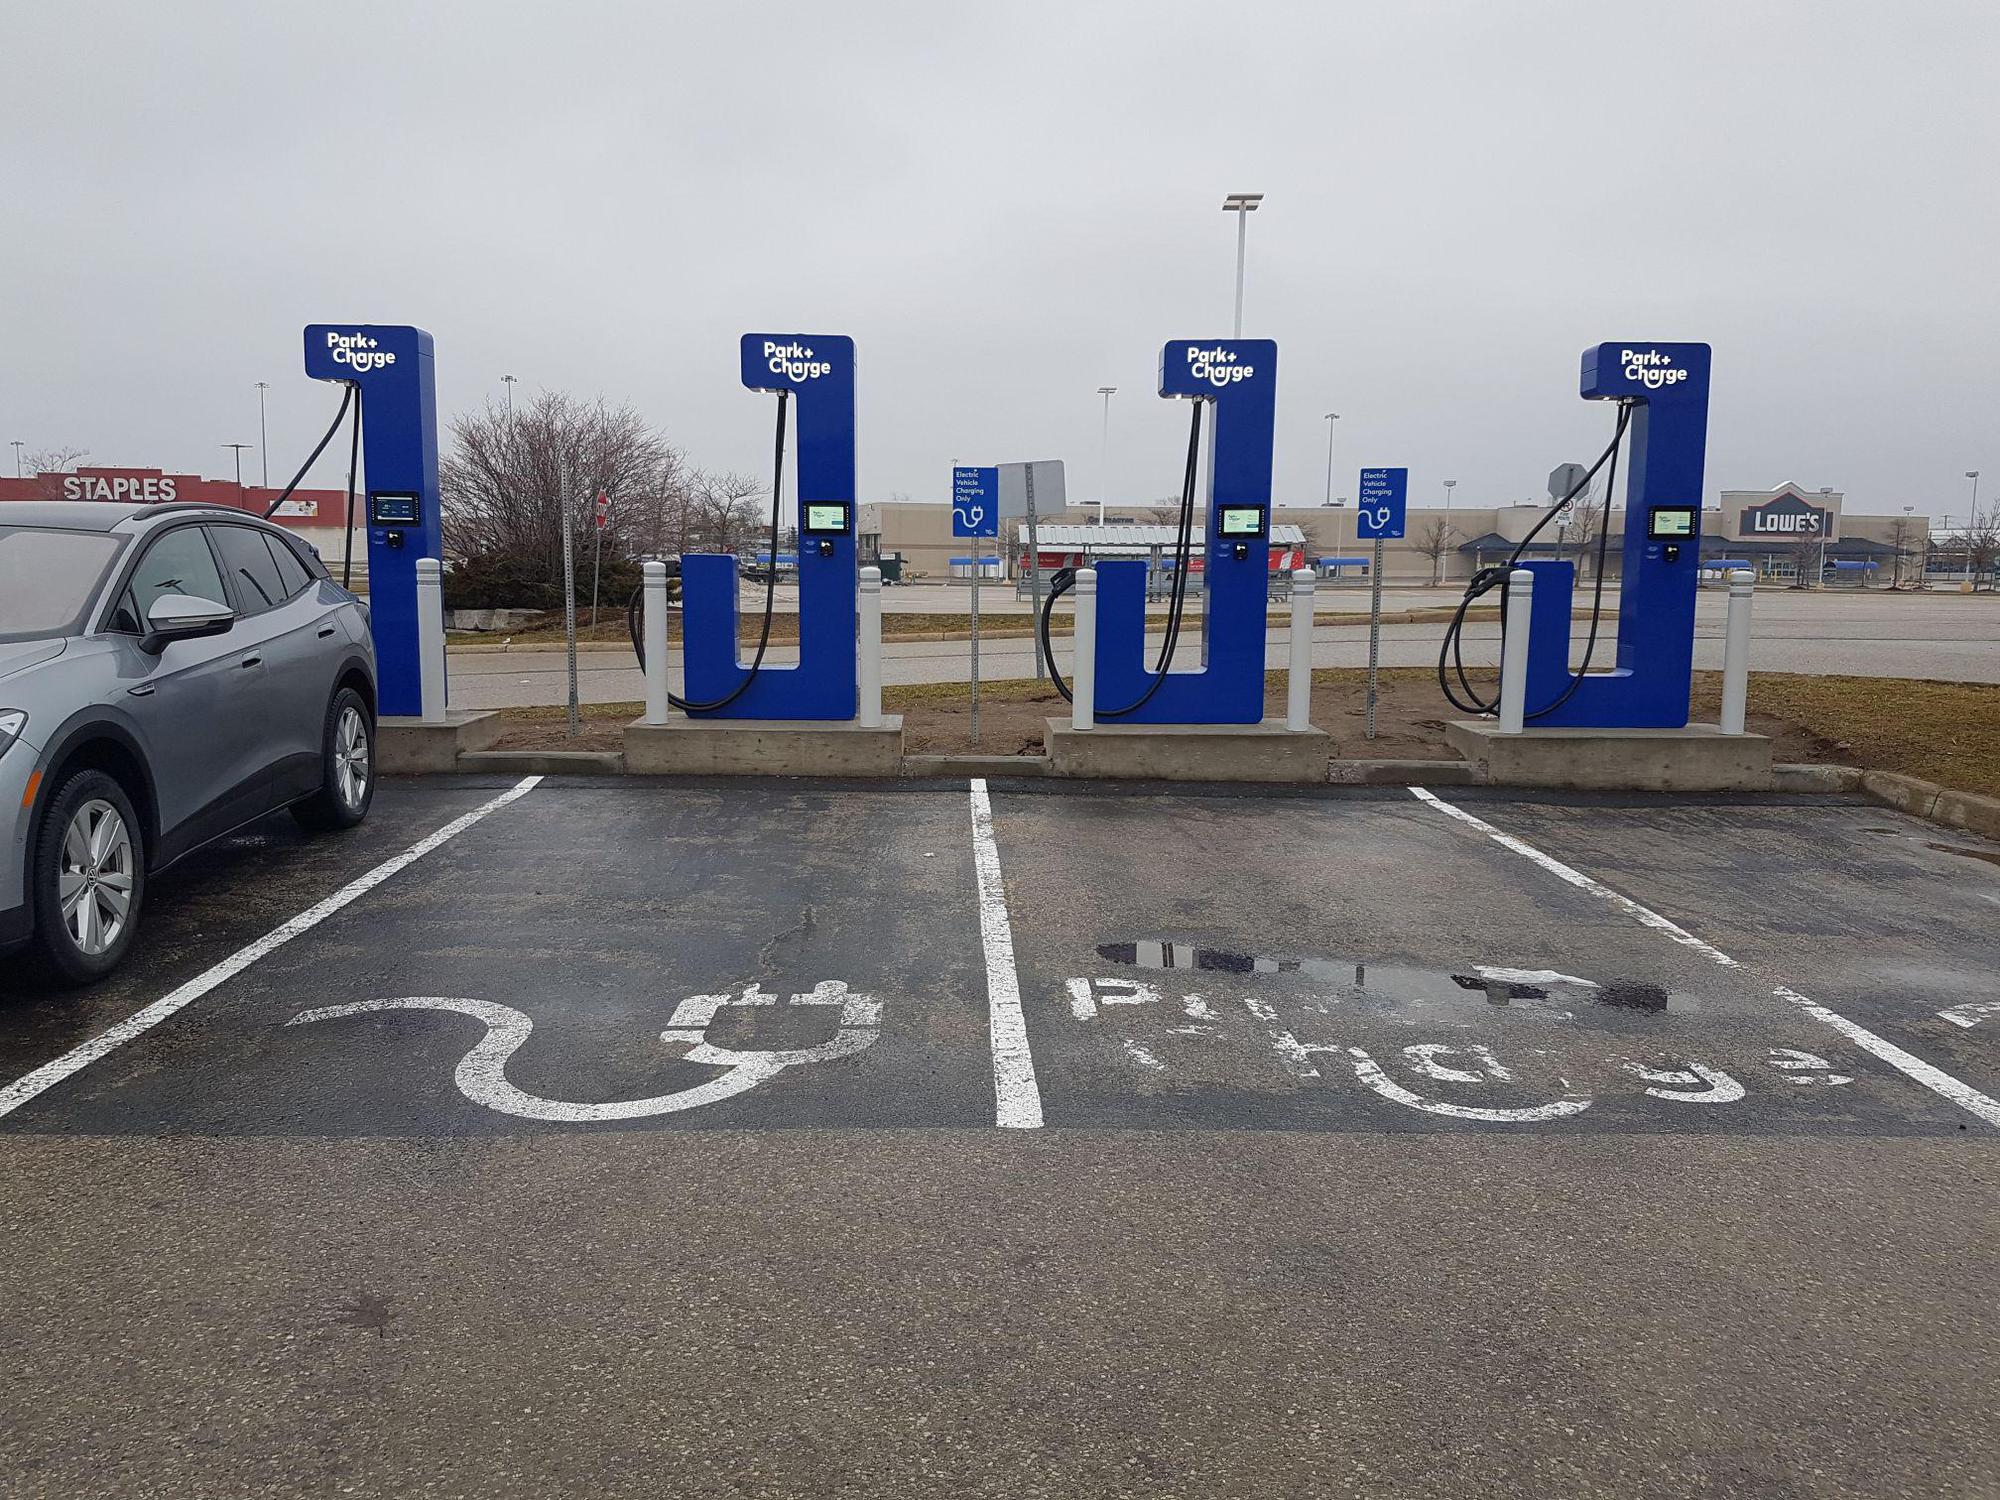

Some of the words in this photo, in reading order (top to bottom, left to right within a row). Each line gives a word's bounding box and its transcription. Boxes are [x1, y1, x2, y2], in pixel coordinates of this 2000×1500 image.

[327, 332, 378, 348] Park+
[763, 341, 814, 358] Park+
[1187, 346, 1237, 363] Park+
[1621, 349, 1671, 365] Park+
[332, 347, 396, 372] Charge
[769, 357, 831, 382] Charge
[1191, 362, 1254, 387] Charge
[1625, 364, 1688, 389] Charge
[63, 476, 177, 501] STAPLES
[955, 487, 984, 496] Charging
[1362, 488, 1392, 497] Charging
[955, 495, 971, 504] Only
[1362, 496, 1378, 505] Only
[1754, 511, 1820, 533] LOWE'S
